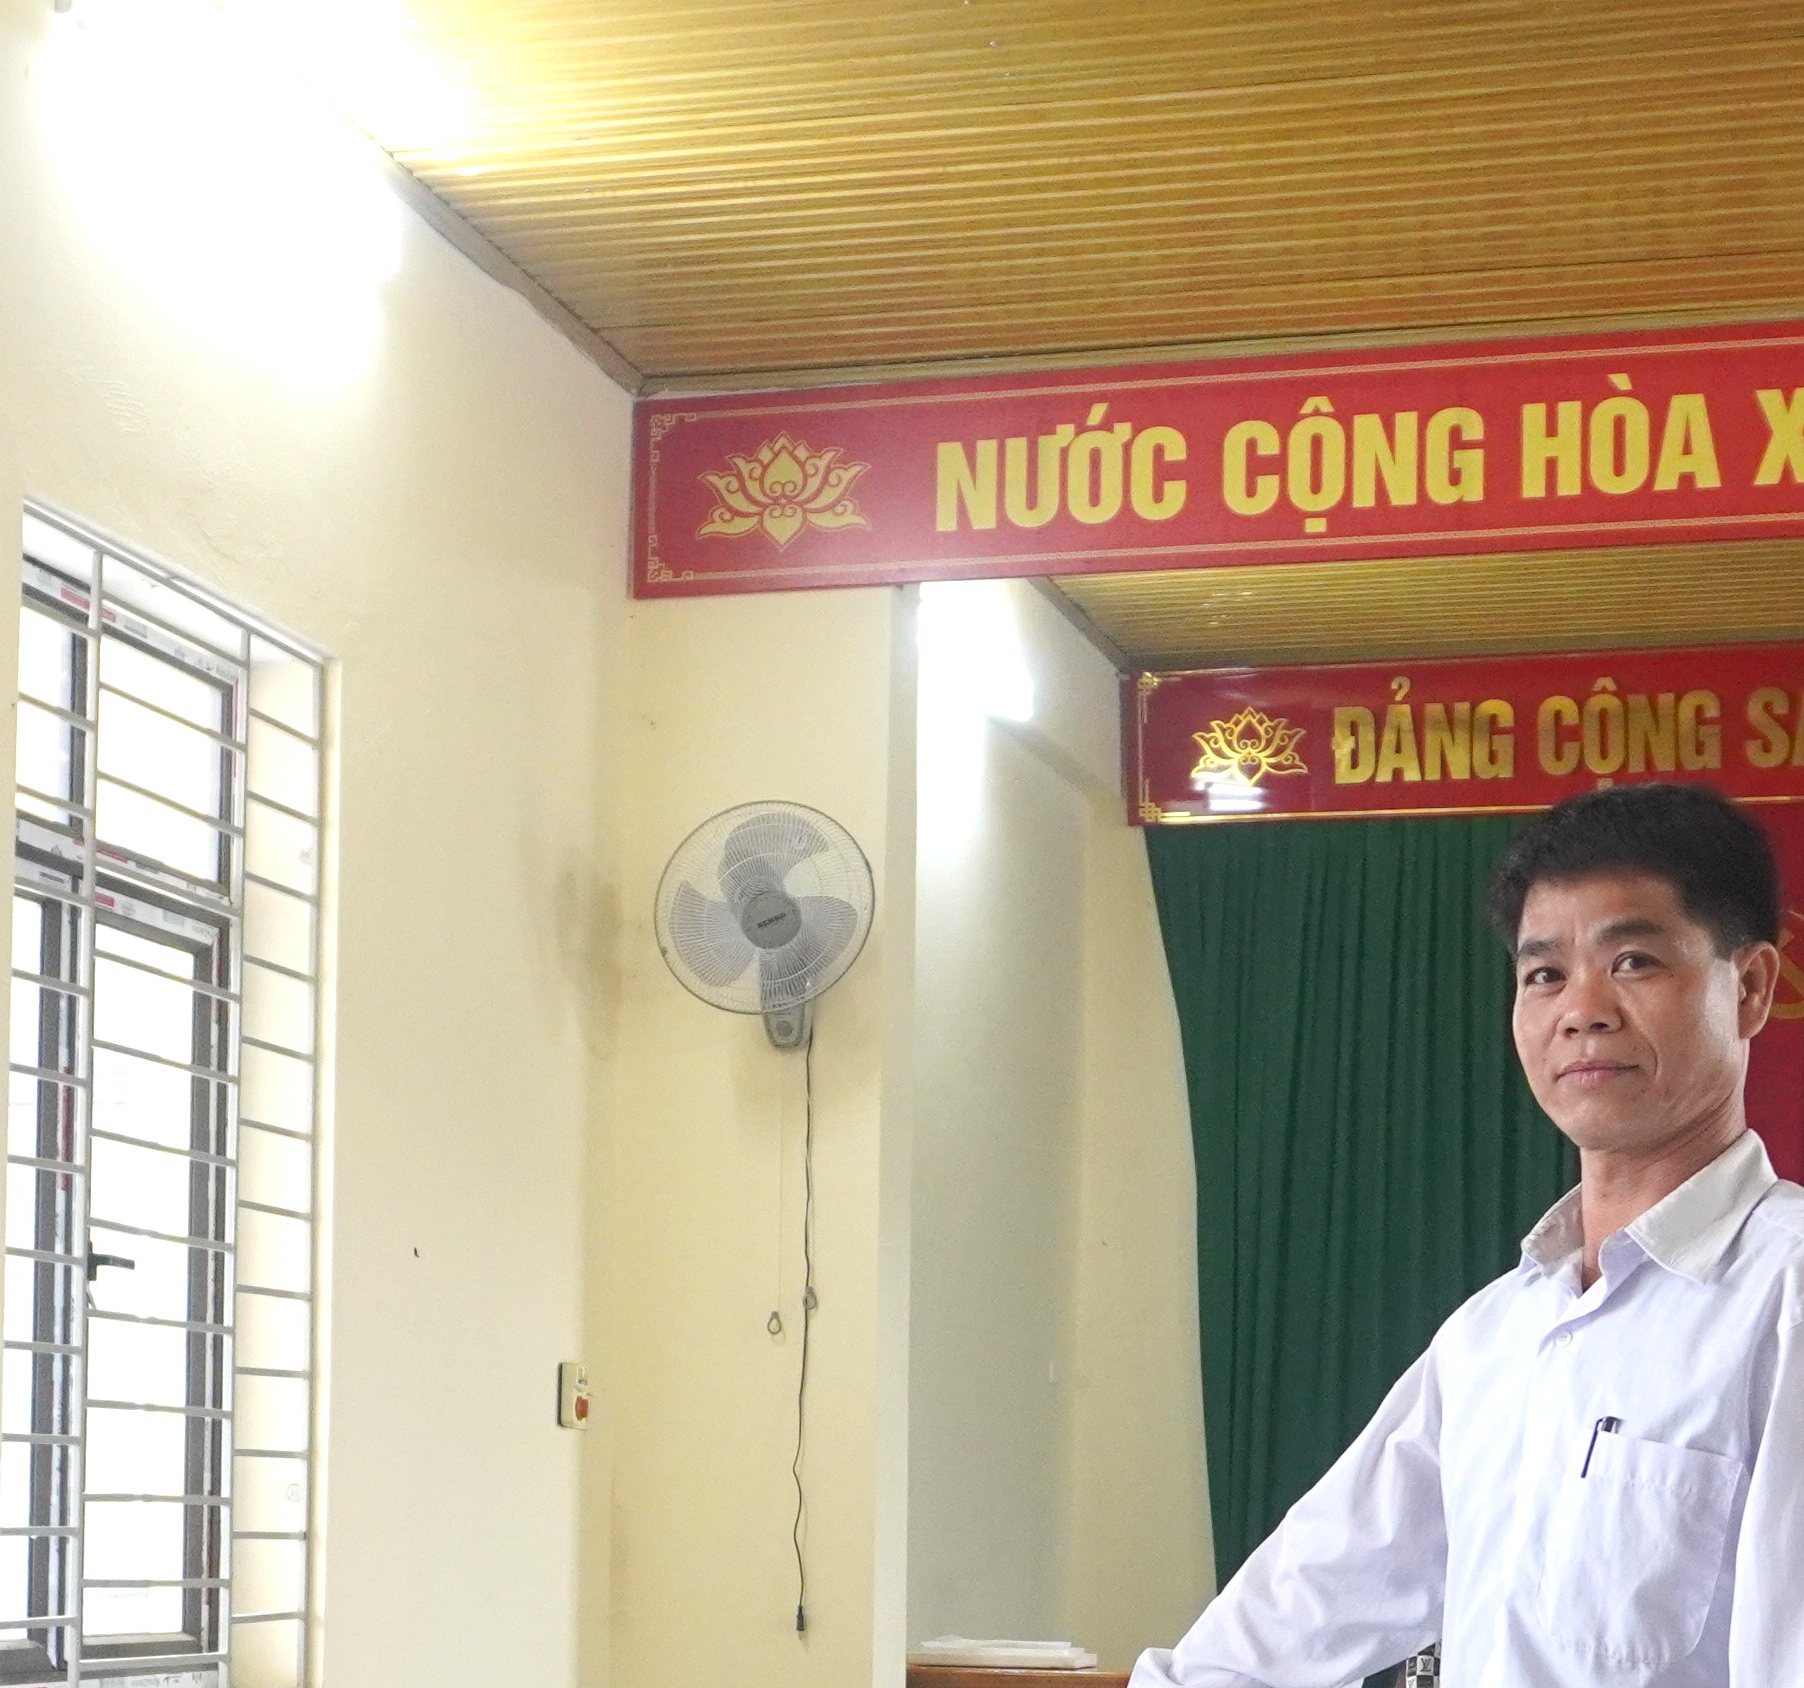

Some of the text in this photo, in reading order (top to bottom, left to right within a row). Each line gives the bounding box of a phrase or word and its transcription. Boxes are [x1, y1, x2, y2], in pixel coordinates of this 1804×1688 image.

[936, 403, 1188, 533] NƯỚC
[1222, 396, 1485, 534] CỘNG
[1520, 373, 1721, 499] HÒA
[1331, 676, 1516, 786] ĐẢNG
[1537, 676, 1722, 791] CỘNG
